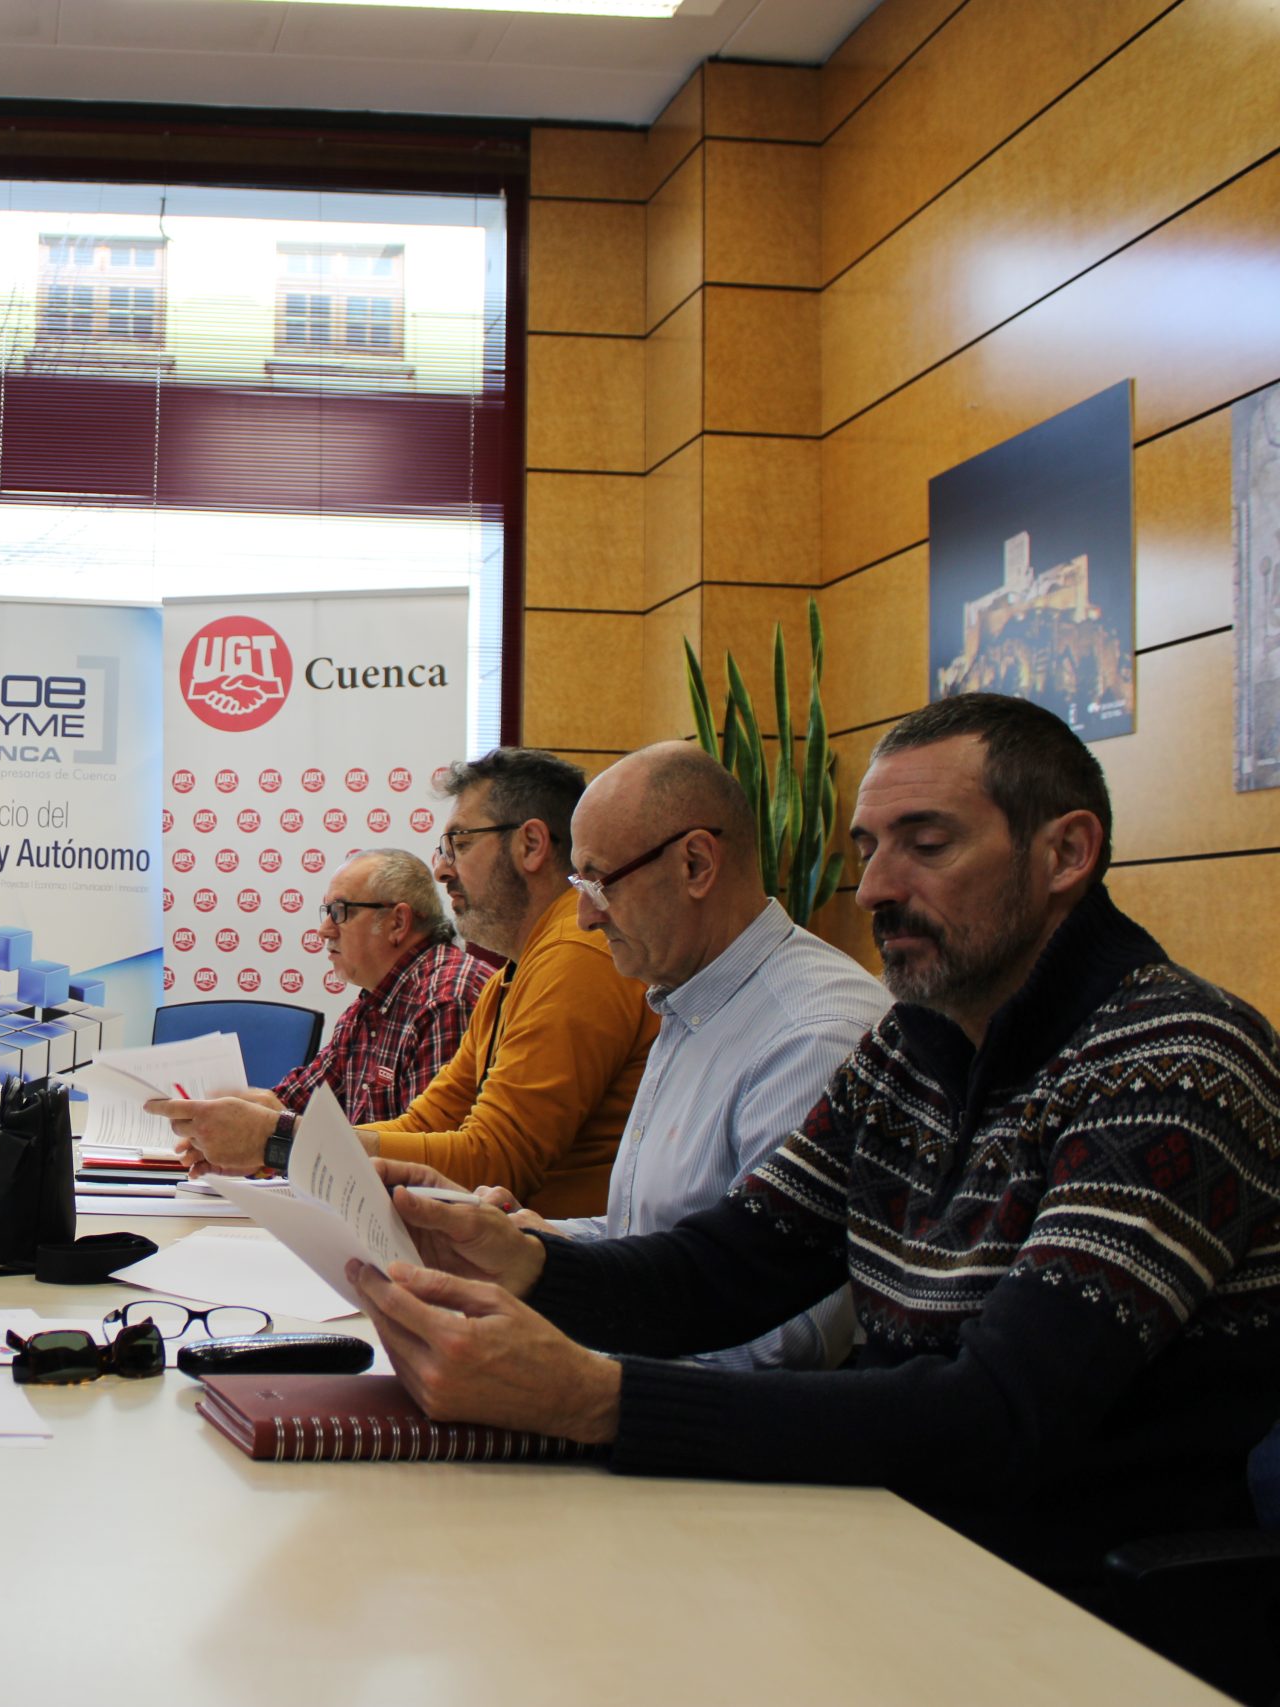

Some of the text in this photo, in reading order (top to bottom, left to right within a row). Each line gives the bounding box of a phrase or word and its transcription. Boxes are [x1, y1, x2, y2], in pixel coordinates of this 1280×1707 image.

[193, 635, 448, 690] UGT Cuenca
[55, 768, 69, 780] de
[73, 769, 117, 782] Cuenca
[37, 800, 69, 829] del
[16, 838, 151, 872] Autónomo
